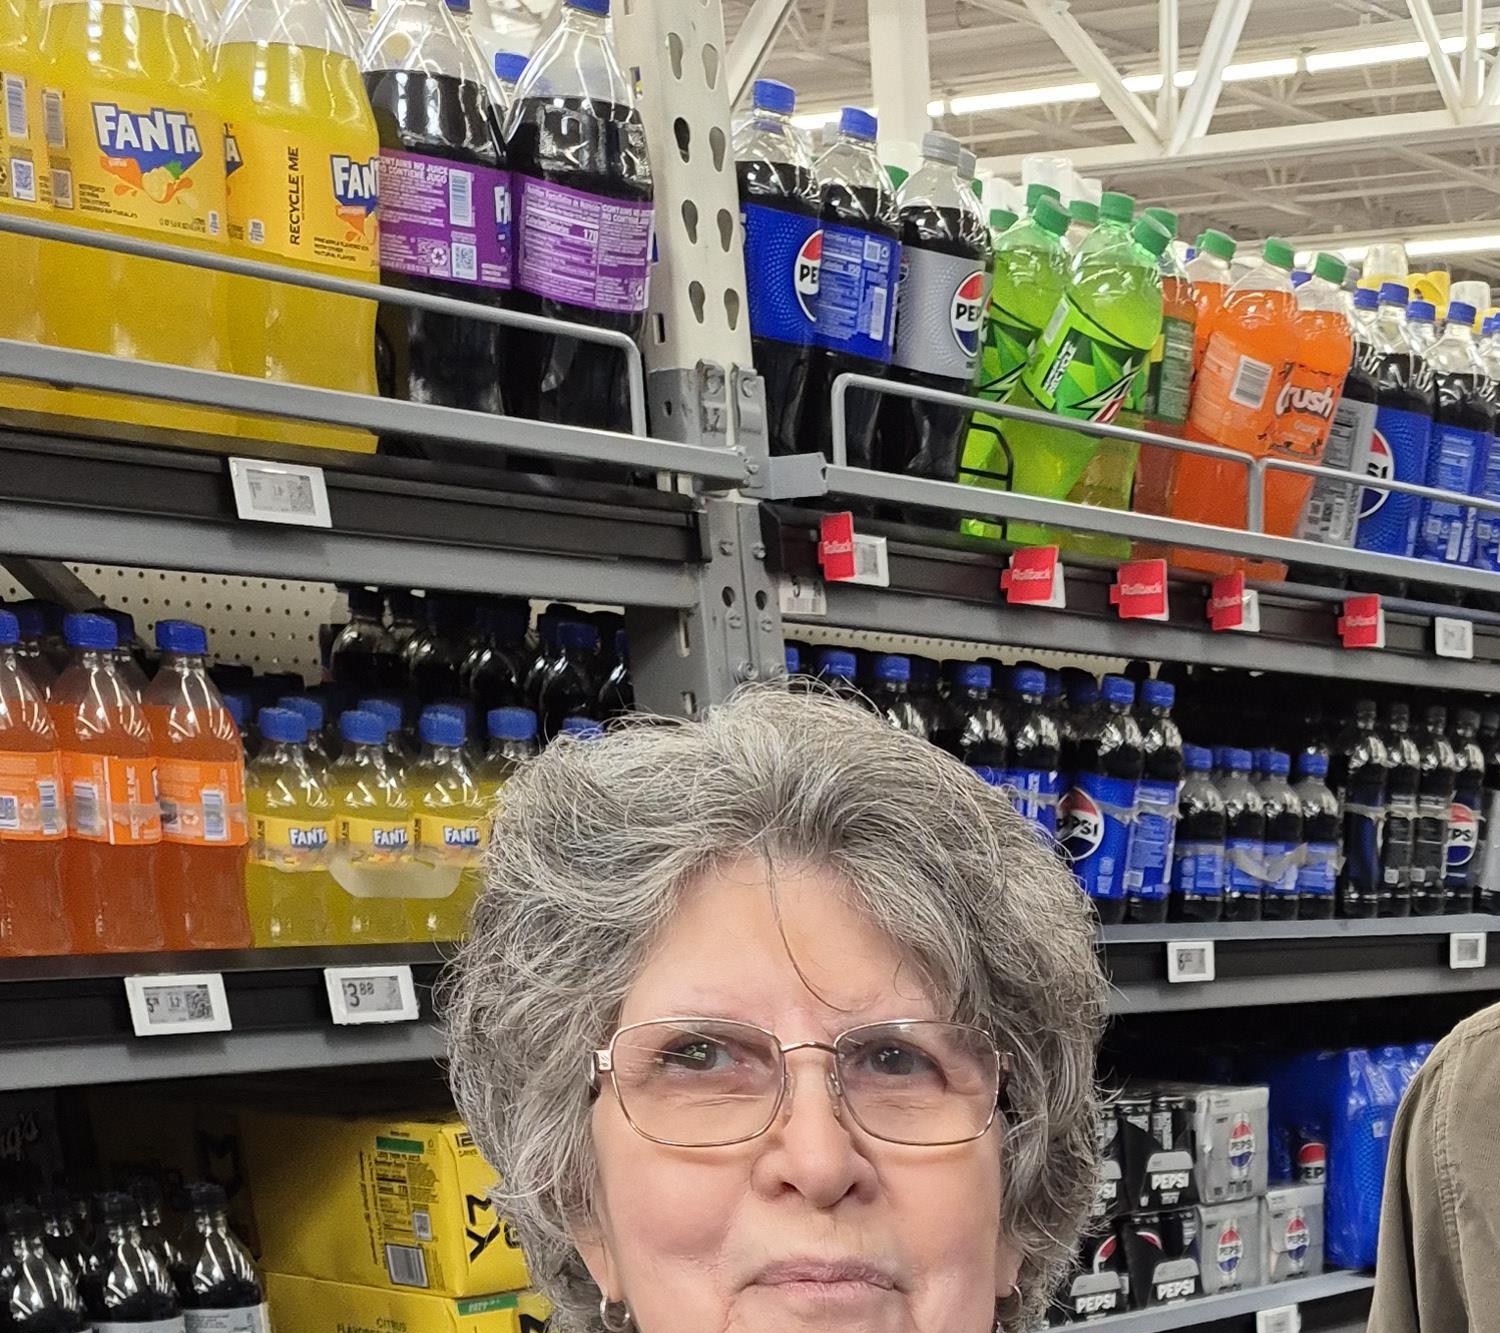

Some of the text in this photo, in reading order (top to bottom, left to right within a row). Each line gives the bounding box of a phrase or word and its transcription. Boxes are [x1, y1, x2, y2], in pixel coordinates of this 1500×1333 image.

[93, 104, 200, 155] FANTA
[287, 146, 301, 246] RECYCLE ME
[1120, 581, 1162, 596] Rollback
[1151, 1170, 1190, 1191] PEPSI
[1157, 1279, 1195, 1301] PEPSI
[376, 1317, 407, 1332] CITRUS
